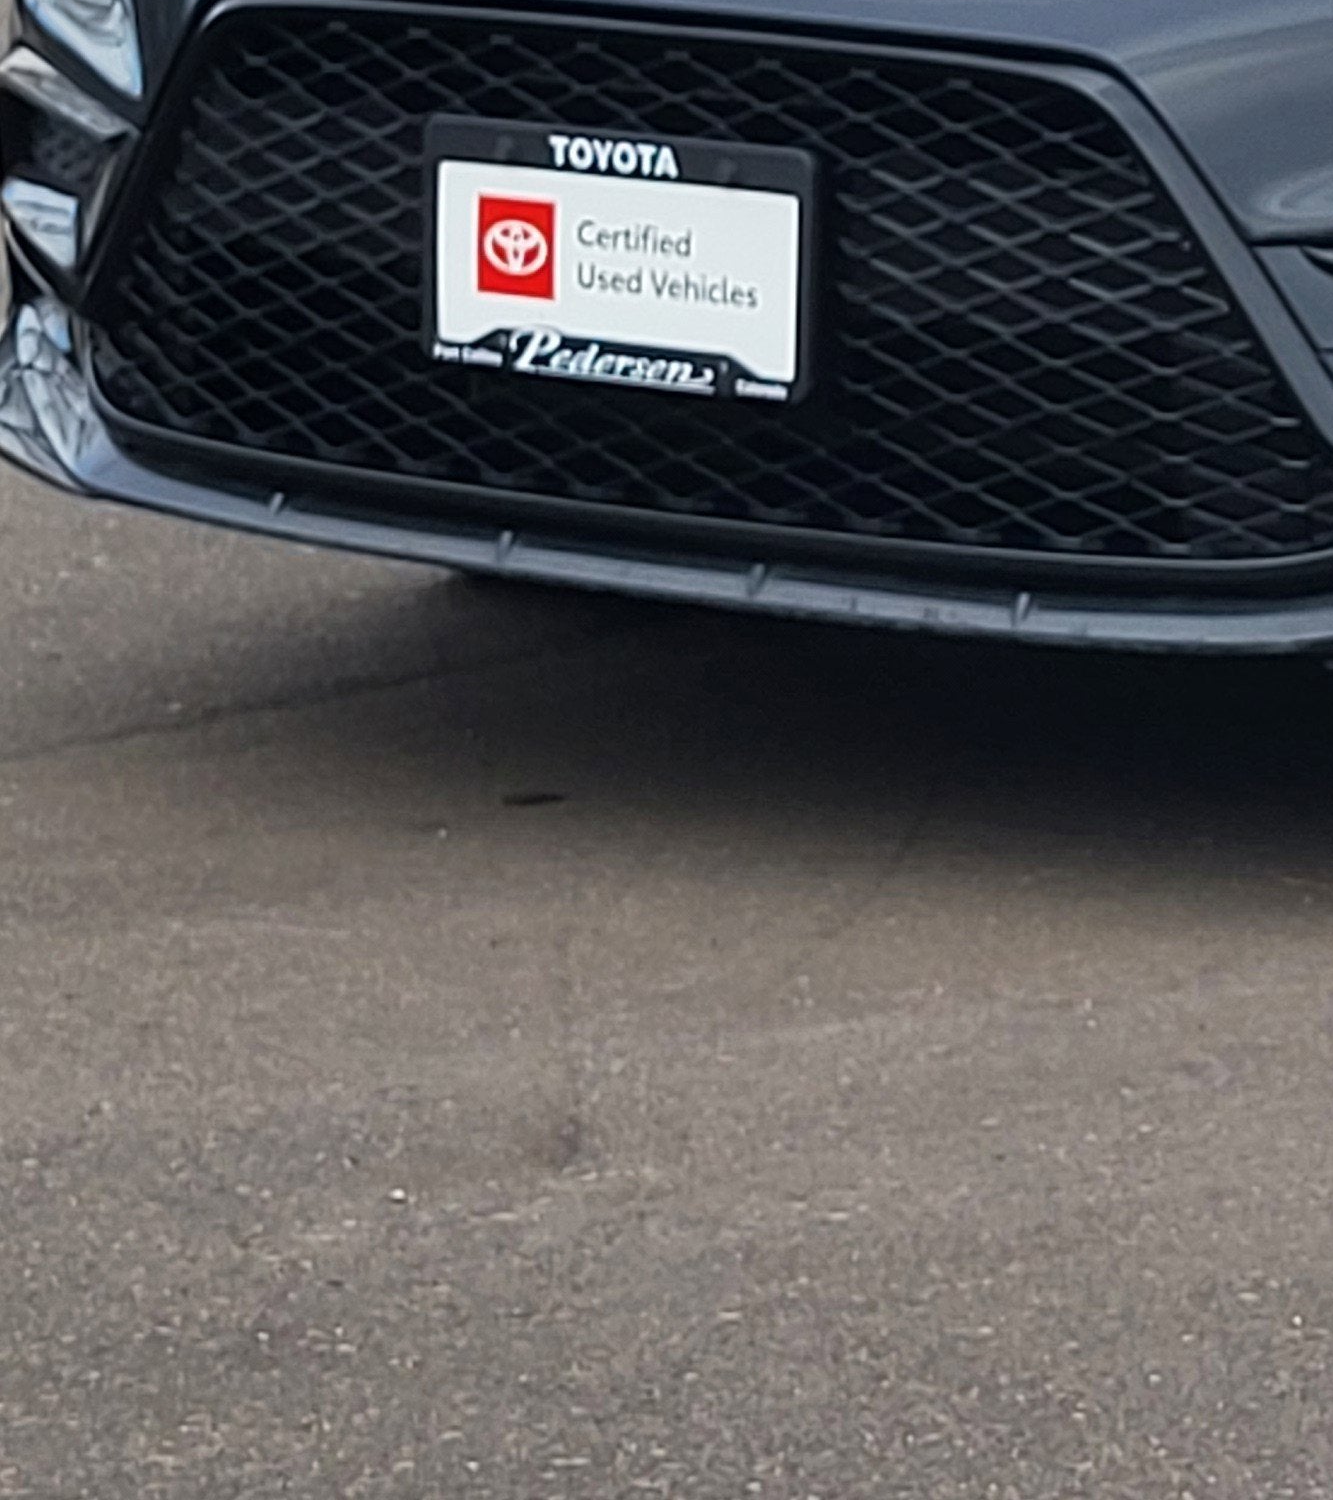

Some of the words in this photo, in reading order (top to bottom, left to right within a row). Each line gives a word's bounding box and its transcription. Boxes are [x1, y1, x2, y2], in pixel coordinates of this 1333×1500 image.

[548, 134, 680, 179] TOYOTA
[576, 219, 693, 258] Certified
[576, 262, 643, 295] Used
[650, 270, 759, 309] Vehicles
[508, 327, 714, 387] Pedersen
